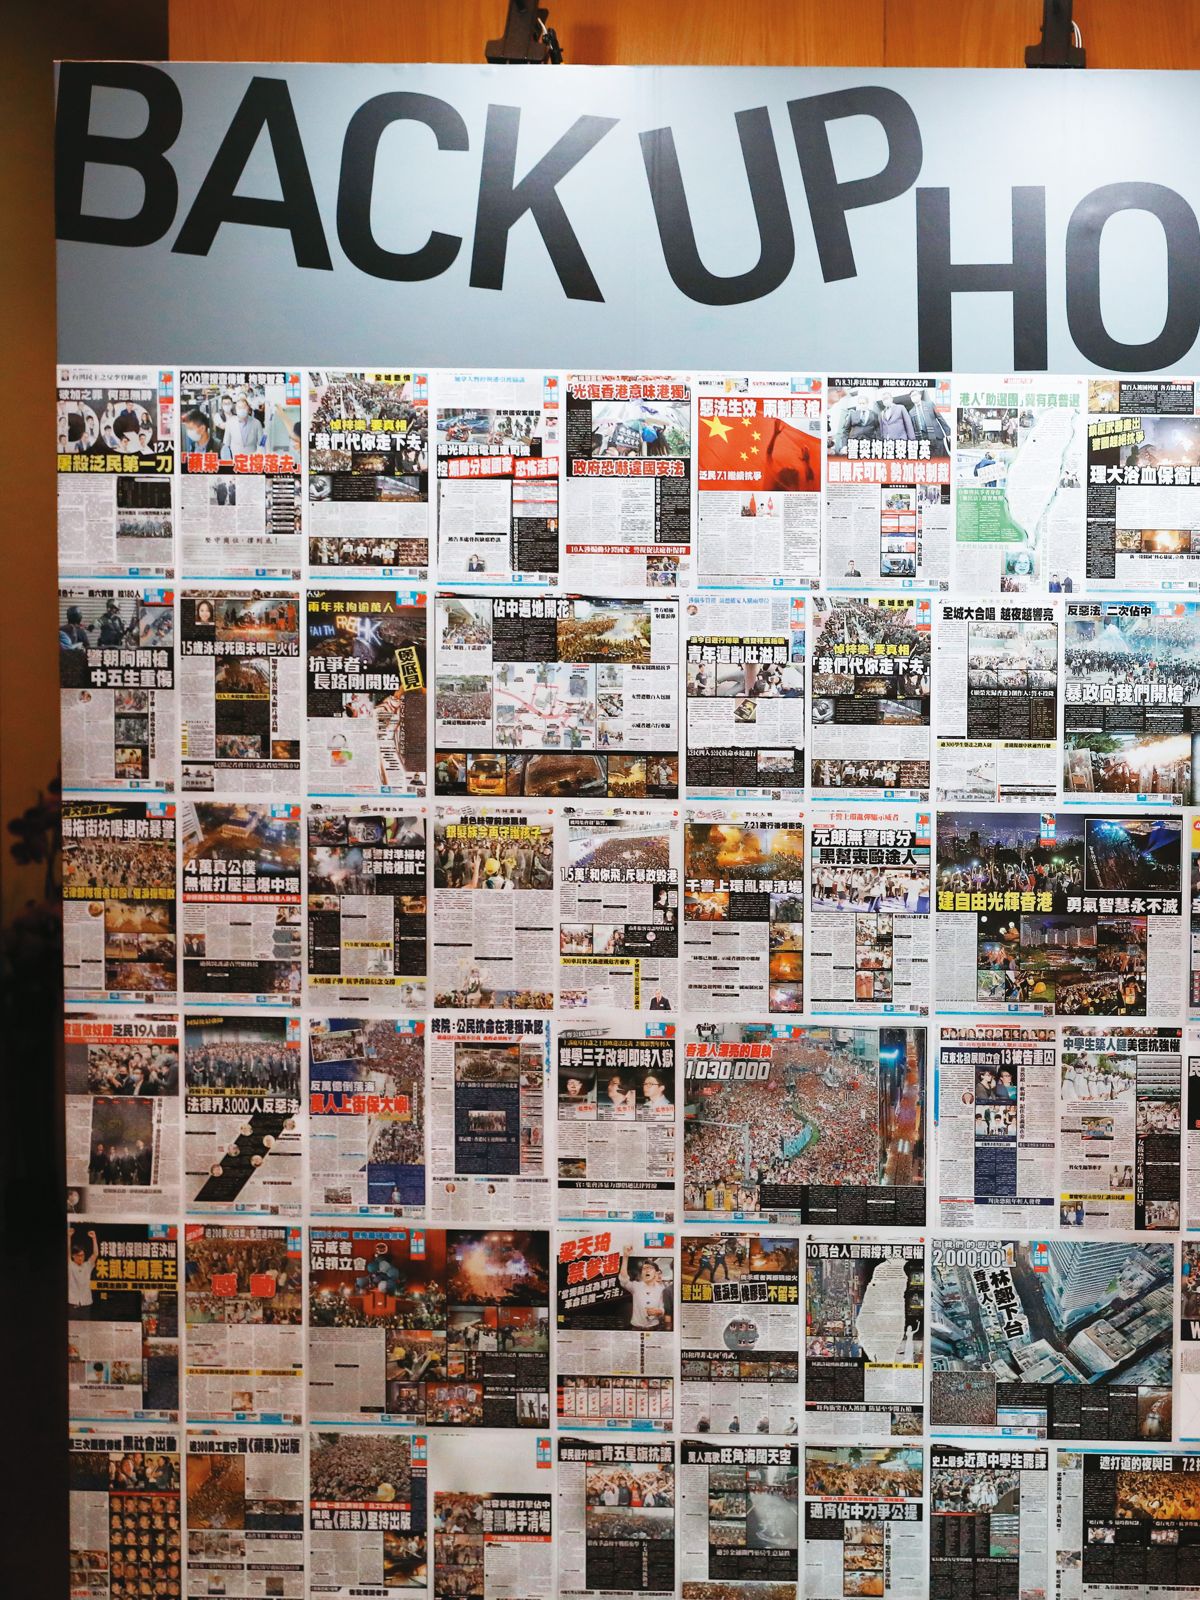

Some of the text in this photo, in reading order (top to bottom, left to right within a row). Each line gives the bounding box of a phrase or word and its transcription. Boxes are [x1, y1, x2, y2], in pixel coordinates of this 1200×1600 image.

[55, 61, 924, 306] BACK UP
[566, 383, 692, 400] 「光復香港意味港獨」
[308, 431, 428, 453] 「我們代你走下去」
[57, 455, 173, 474] 屠殺泛民第一刀
[181, 453, 302, 475] 「蘋果一定撐落去」
[572, 459, 686, 478] 政府恐嚇違國安法
[308, 601, 394, 613] 兩年來拘逾萬人
[494, 600, 570, 619] 佔中遍地開花
[943, 606, 1054, 621] 全城大合唱 越夜越響亮
[1067, 605, 1151, 617] 反惡法 二次佔中
[181, 641, 299, 656] 15歲泳將死因未明已火化
[86, 650, 169, 668] 警朝胸開槍
[812, 656, 931, 677] 「我們代你走下去」
[400, 648, 421, 690] 煲底見
[90, 670, 172, 688] 中五生重傷
[314, 674, 399, 691] 長路剛開始
[1065, 683, 1184, 704] 暴政向我們開槍
[813, 829, 912, 847] 元朗無警時分
[819, 848, 917, 865] 黑幫喪毆途人
[185, 859, 256, 875] 4萬真公僕
[560, 867, 678, 883] 1.5萬「和你飛」斥暴政毀港
[184, 877, 300, 893] 無懼打壓逼爆中環
[686, 879, 803, 895] 千警上環亂彈清場
[938, 891, 1053, 913] 建自由光輝香港
[1066, 896, 1179, 914] 勇氣智慧永不滅
[431, 1018, 544, 1035] 終院：公民抗命在港獲承認
[559, 1048, 674, 1068] 雙學三子改判即時入獄
[685, 1060, 770, 1080] 1,030,000
[187, 1097, 299, 1114] 法律界3,000人反惡法
[311, 1094, 410, 1115] 萬人上街保大嶼
[312, 1241, 353, 1255] 示威者
[559, 1232, 612, 1264] 梁天琦
[806, 1244, 924, 1260] 10萬台人冒雨撐港反極權
[312, 1257, 367, 1272] 佔領立會
[567, 1252, 620, 1284] 禁參選
[768, 1283, 799, 1302] 不留手
[989, 1269, 1026, 1340] 林鄭下台
[932, 1452, 1048, 1470] 史上最多近萬中學生罷課
[1100, 1455, 1173, 1472] 遮打道的夜與日
[810, 1503, 919, 1521] 通宵佔中力爭公提
